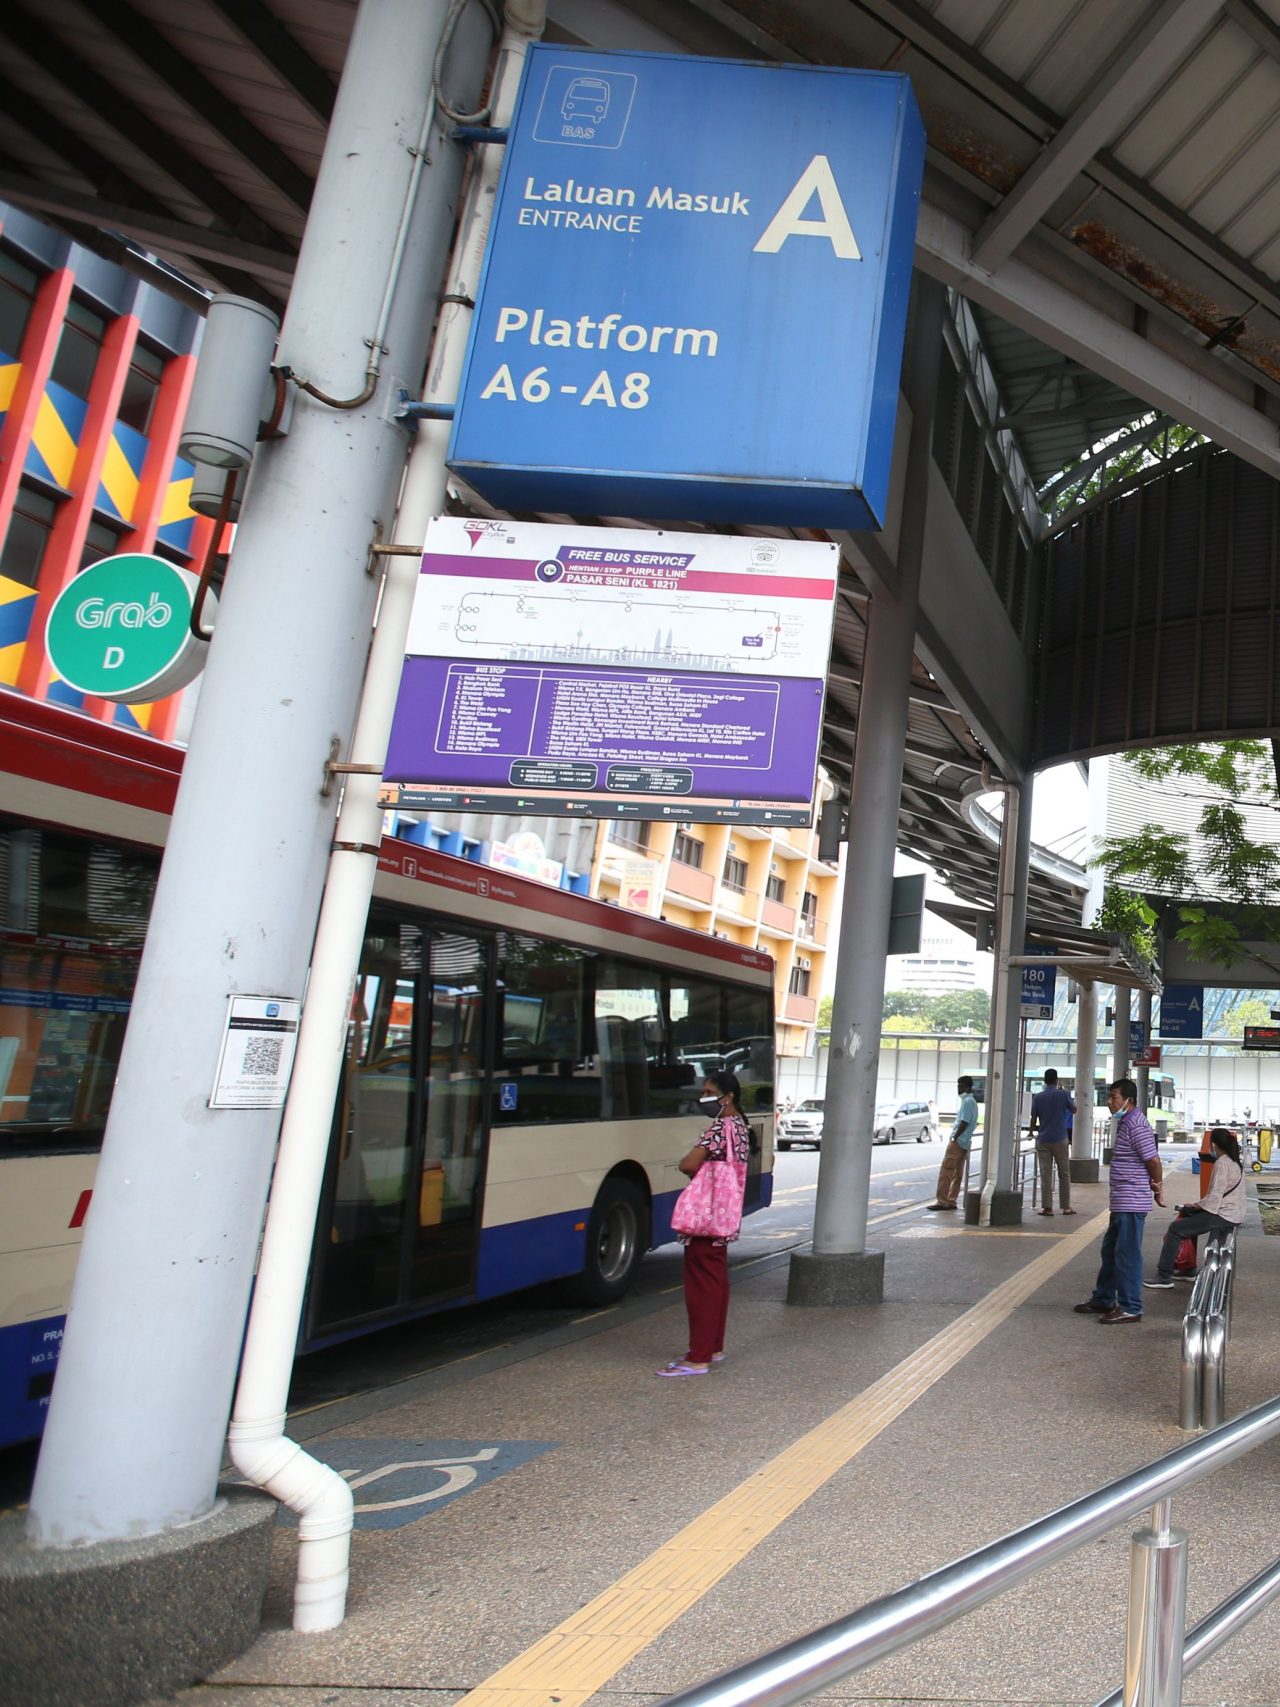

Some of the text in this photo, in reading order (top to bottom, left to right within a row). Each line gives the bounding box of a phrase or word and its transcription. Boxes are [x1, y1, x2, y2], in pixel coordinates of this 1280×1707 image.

[561, 125, 595, 140] BAS
[523, 177, 751, 216] Laluan Masuk
[752, 154, 862, 261] A
[518, 208, 644, 234] ENTRANCE
[494, 307, 719, 357] Platform
[463, 520, 507, 533] GOKL
[568, 549, 688, 567] FREE BUS SERVICE
[568, 565, 600, 573] HENTIAN
[626, 566, 664, 578] PURPLE
[665, 569, 688, 579] LINE
[566, 574, 678, 591] PASAR SENI (KL 1821)
[75, 592, 172, 629] Grab
[102, 646, 125, 669] D
[1022, 969, 1045, 982] 180
[1188, 997, 1200, 1011] A
